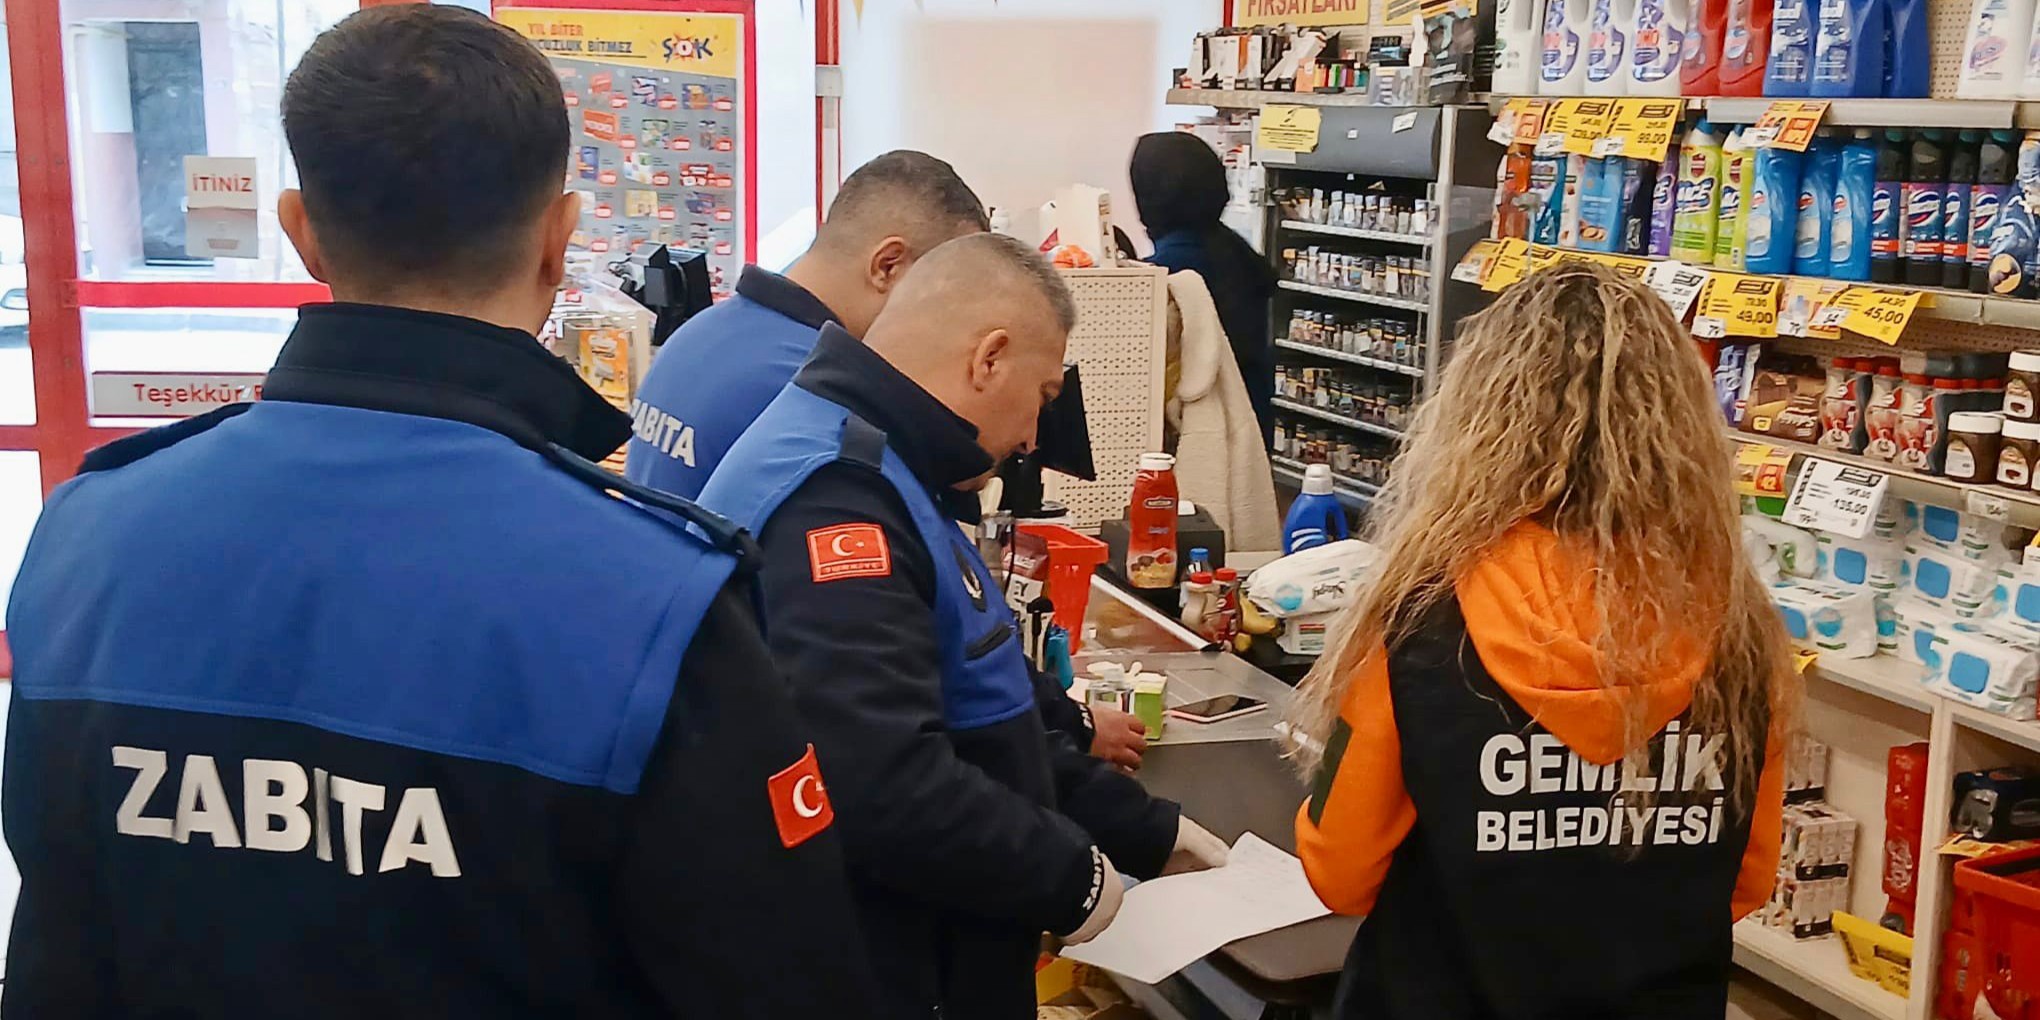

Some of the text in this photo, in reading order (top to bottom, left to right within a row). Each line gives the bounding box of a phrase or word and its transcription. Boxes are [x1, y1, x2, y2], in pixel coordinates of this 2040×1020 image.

[662, 36, 714, 63] ŞOK
[192, 172, 253, 193] İTİNİZ
[1863, 306, 1904, 325] 45,00
[133, 382, 243, 407] Teşekkür
[1479, 720, 1727, 796] GEMLİK
[111, 745, 462, 878] ZABITA
[1476, 796, 1725, 852] BELEDİYESİ
